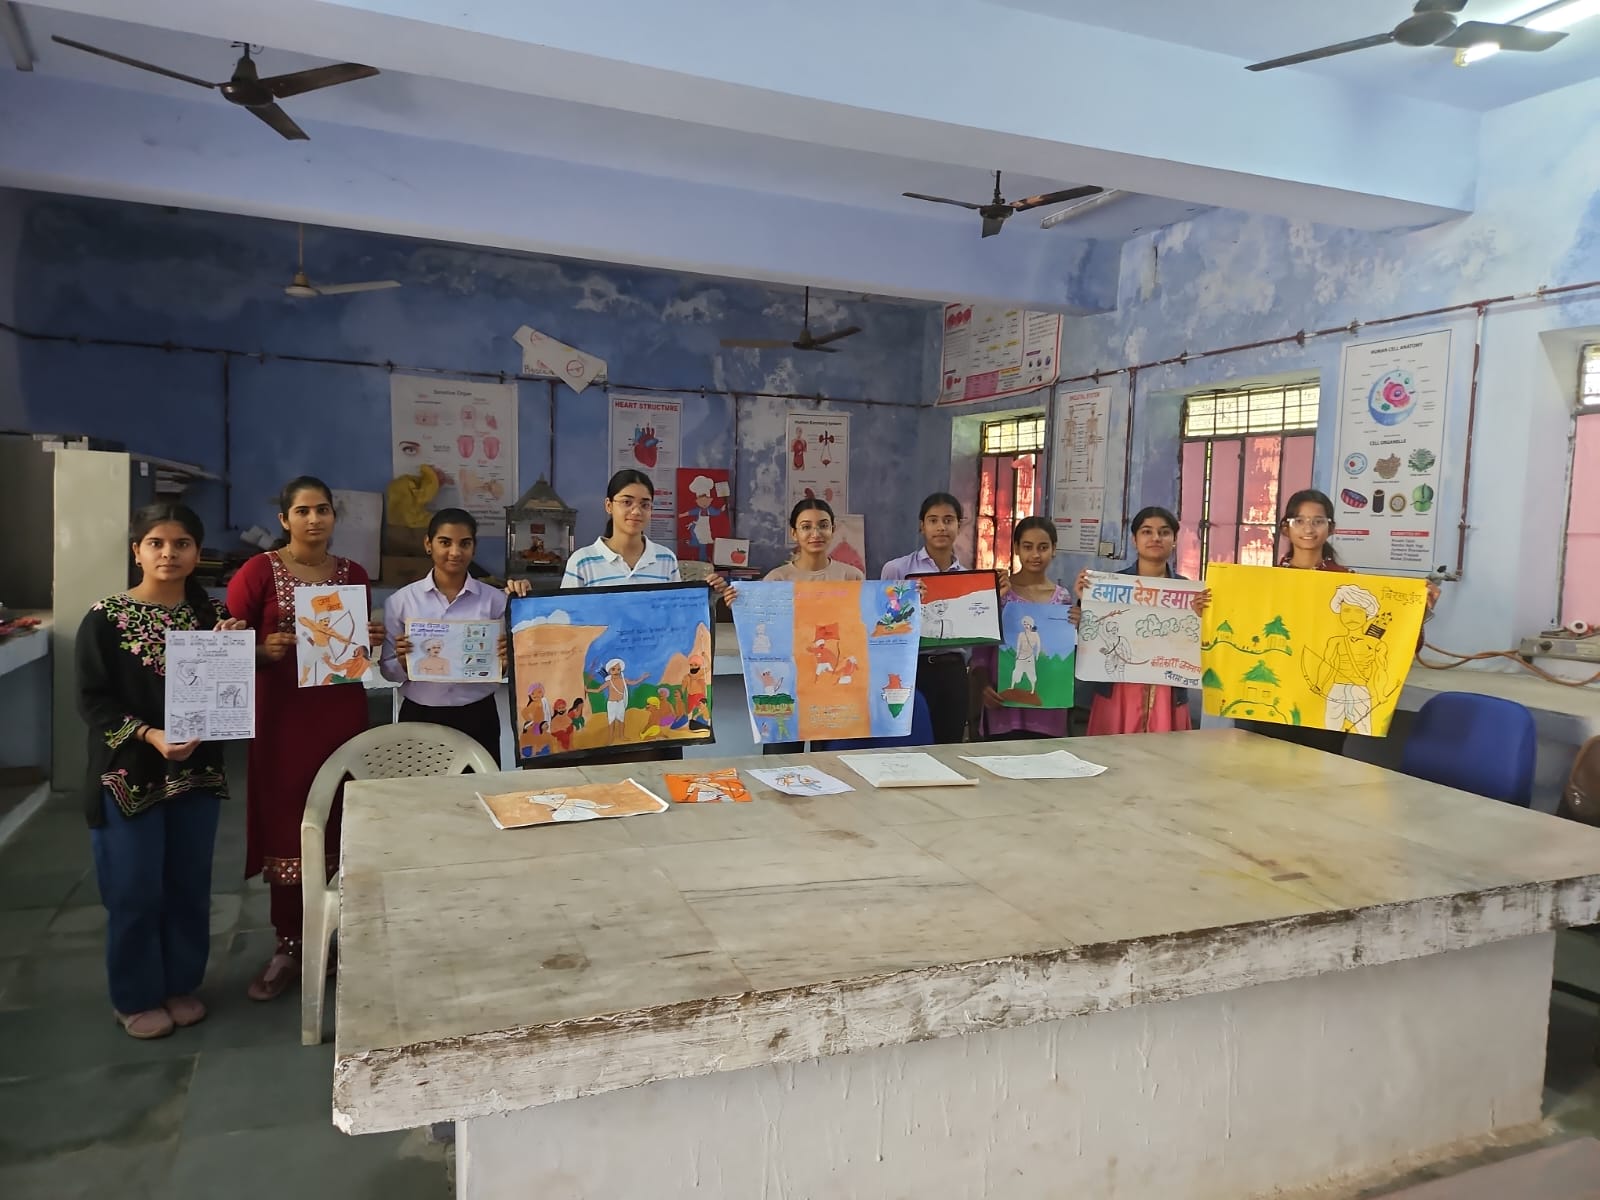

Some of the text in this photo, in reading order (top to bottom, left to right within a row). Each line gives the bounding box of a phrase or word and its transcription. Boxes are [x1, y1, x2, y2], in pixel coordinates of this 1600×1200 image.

[1399, 342, 1424, 350] ANATOMY
[614, 400, 679, 412] HEART STRUCTURE
[1092, 583, 1134, 605] हमारा
[1134, 579, 1161, 608] देश
